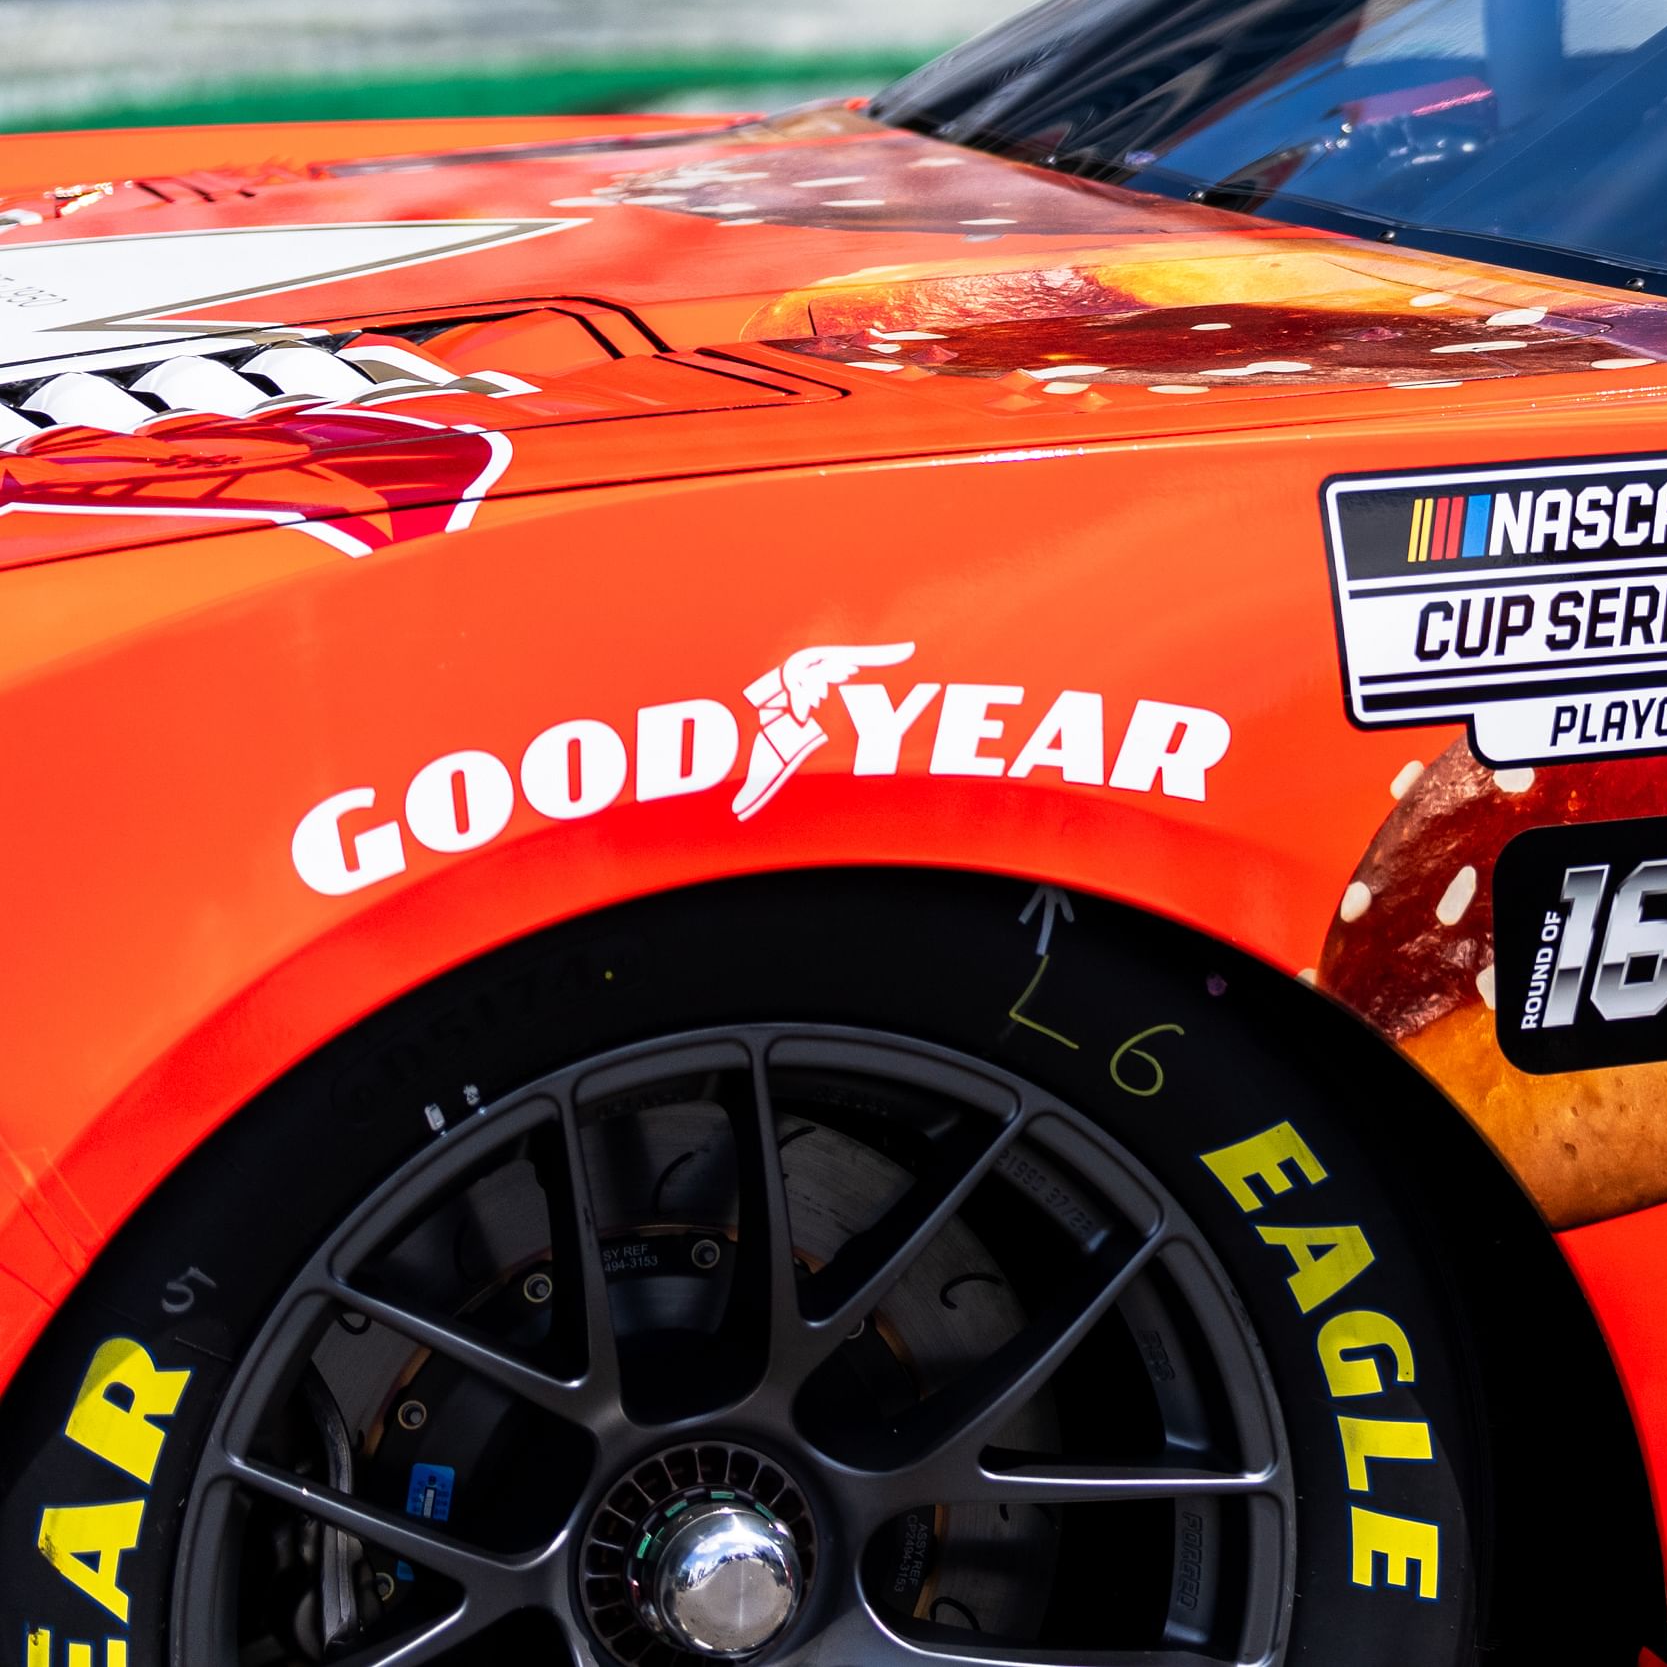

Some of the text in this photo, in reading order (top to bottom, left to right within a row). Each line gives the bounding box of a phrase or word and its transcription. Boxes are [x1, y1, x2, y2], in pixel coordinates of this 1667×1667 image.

[1414, 593, 1535, 662] CUP
[1521, 911, 1562, 1030] ROUND OF
[602, 1243, 649, 1262] SY REF
[605, 1254, 659, 1273] 494-3153
[1200, 1121, 1440, 1600] EAGLE
